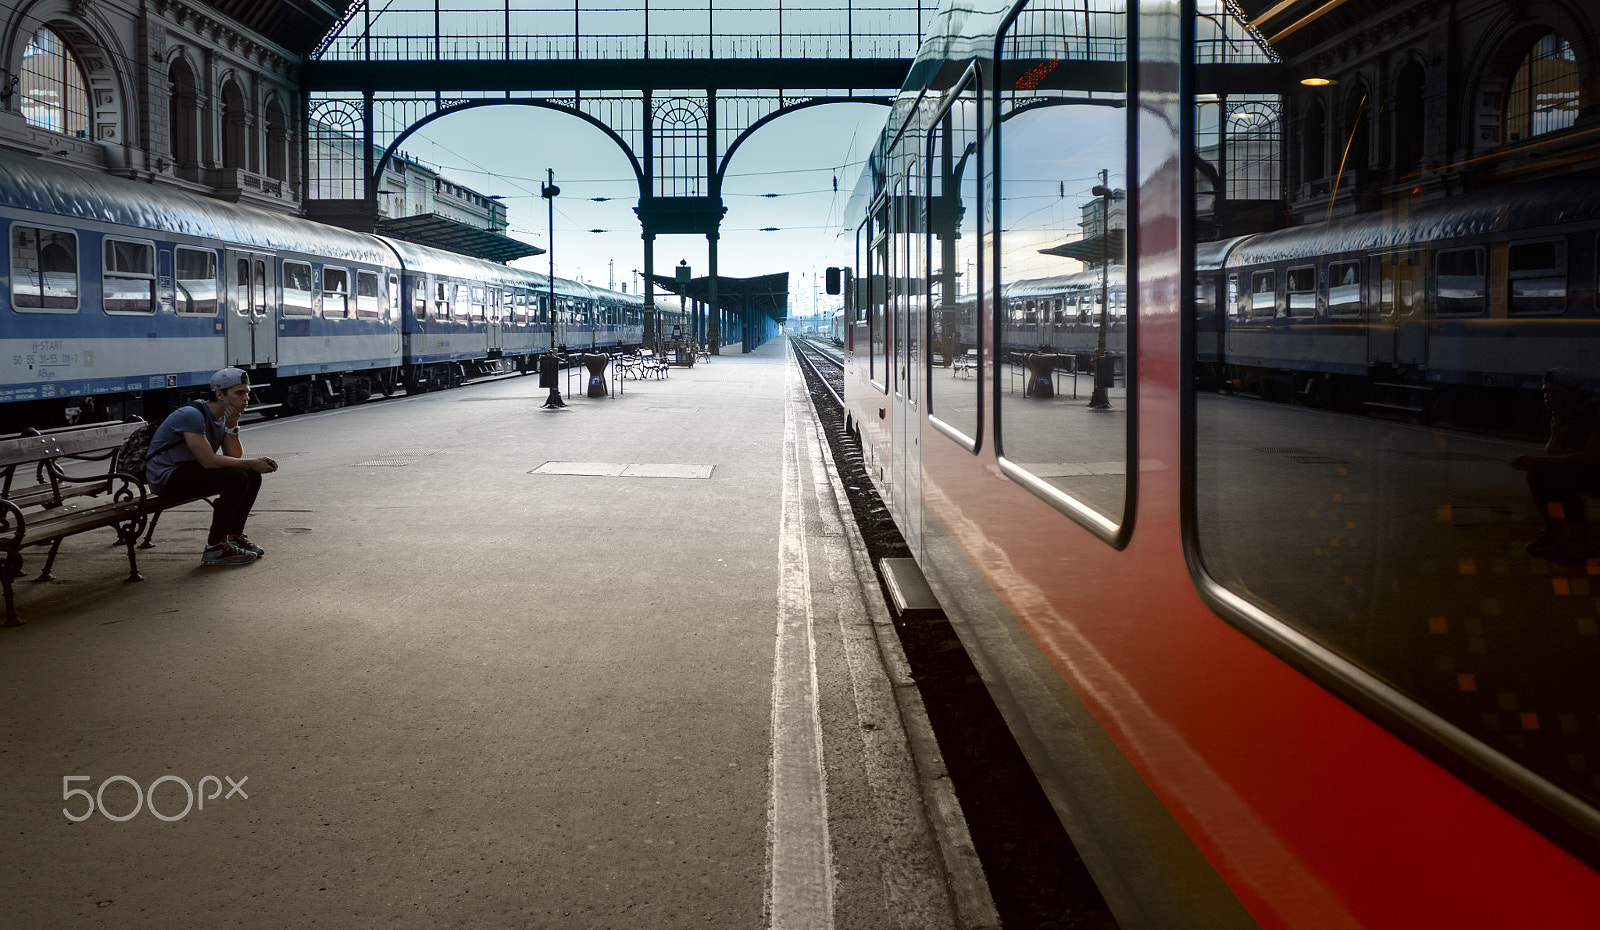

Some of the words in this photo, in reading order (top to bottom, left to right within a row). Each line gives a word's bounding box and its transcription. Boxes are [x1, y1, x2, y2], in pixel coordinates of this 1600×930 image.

[314, 271, 320, 283] 2
[32, 340, 64, 351] H-START
[26, 354, 35, 365] 55
